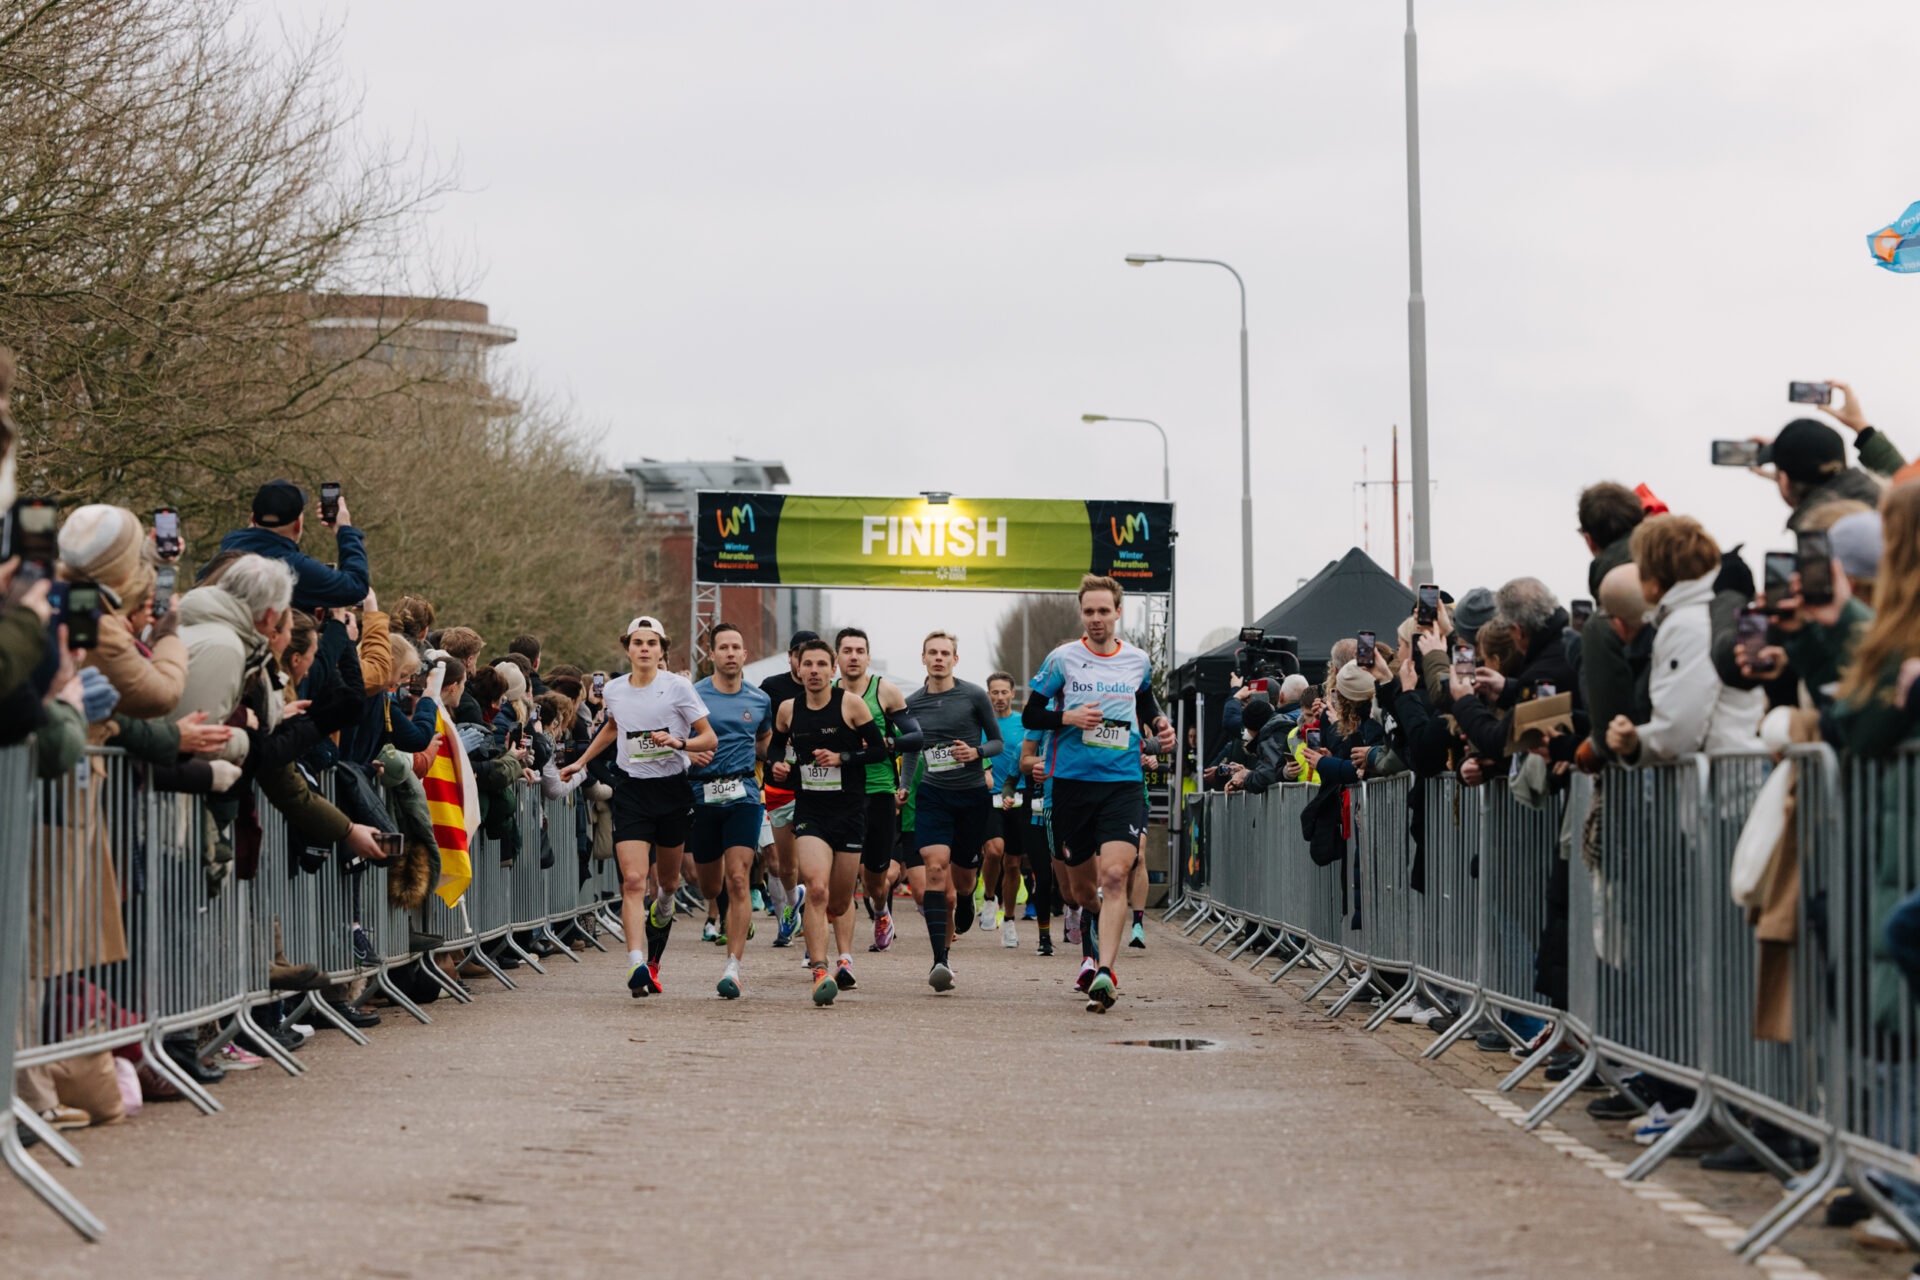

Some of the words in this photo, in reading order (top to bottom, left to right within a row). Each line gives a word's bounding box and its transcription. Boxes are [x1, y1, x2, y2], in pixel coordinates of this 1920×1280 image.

[862, 515, 1007, 557] FINISH
[724, 542, 749, 551] Winter
[718, 552, 755, 560] Marathon
[1118, 550, 1144, 559] Winter
[1112, 560, 1149, 569] Marathon
[1108, 569, 1153, 578] Leeuwarden
[1072, 681, 1093, 692] Bos
[1095, 727, 1119, 740] 2011
[637, 739, 663, 750] 155
[807, 767, 829, 778] 1817
[711, 783, 736, 794] 3043
